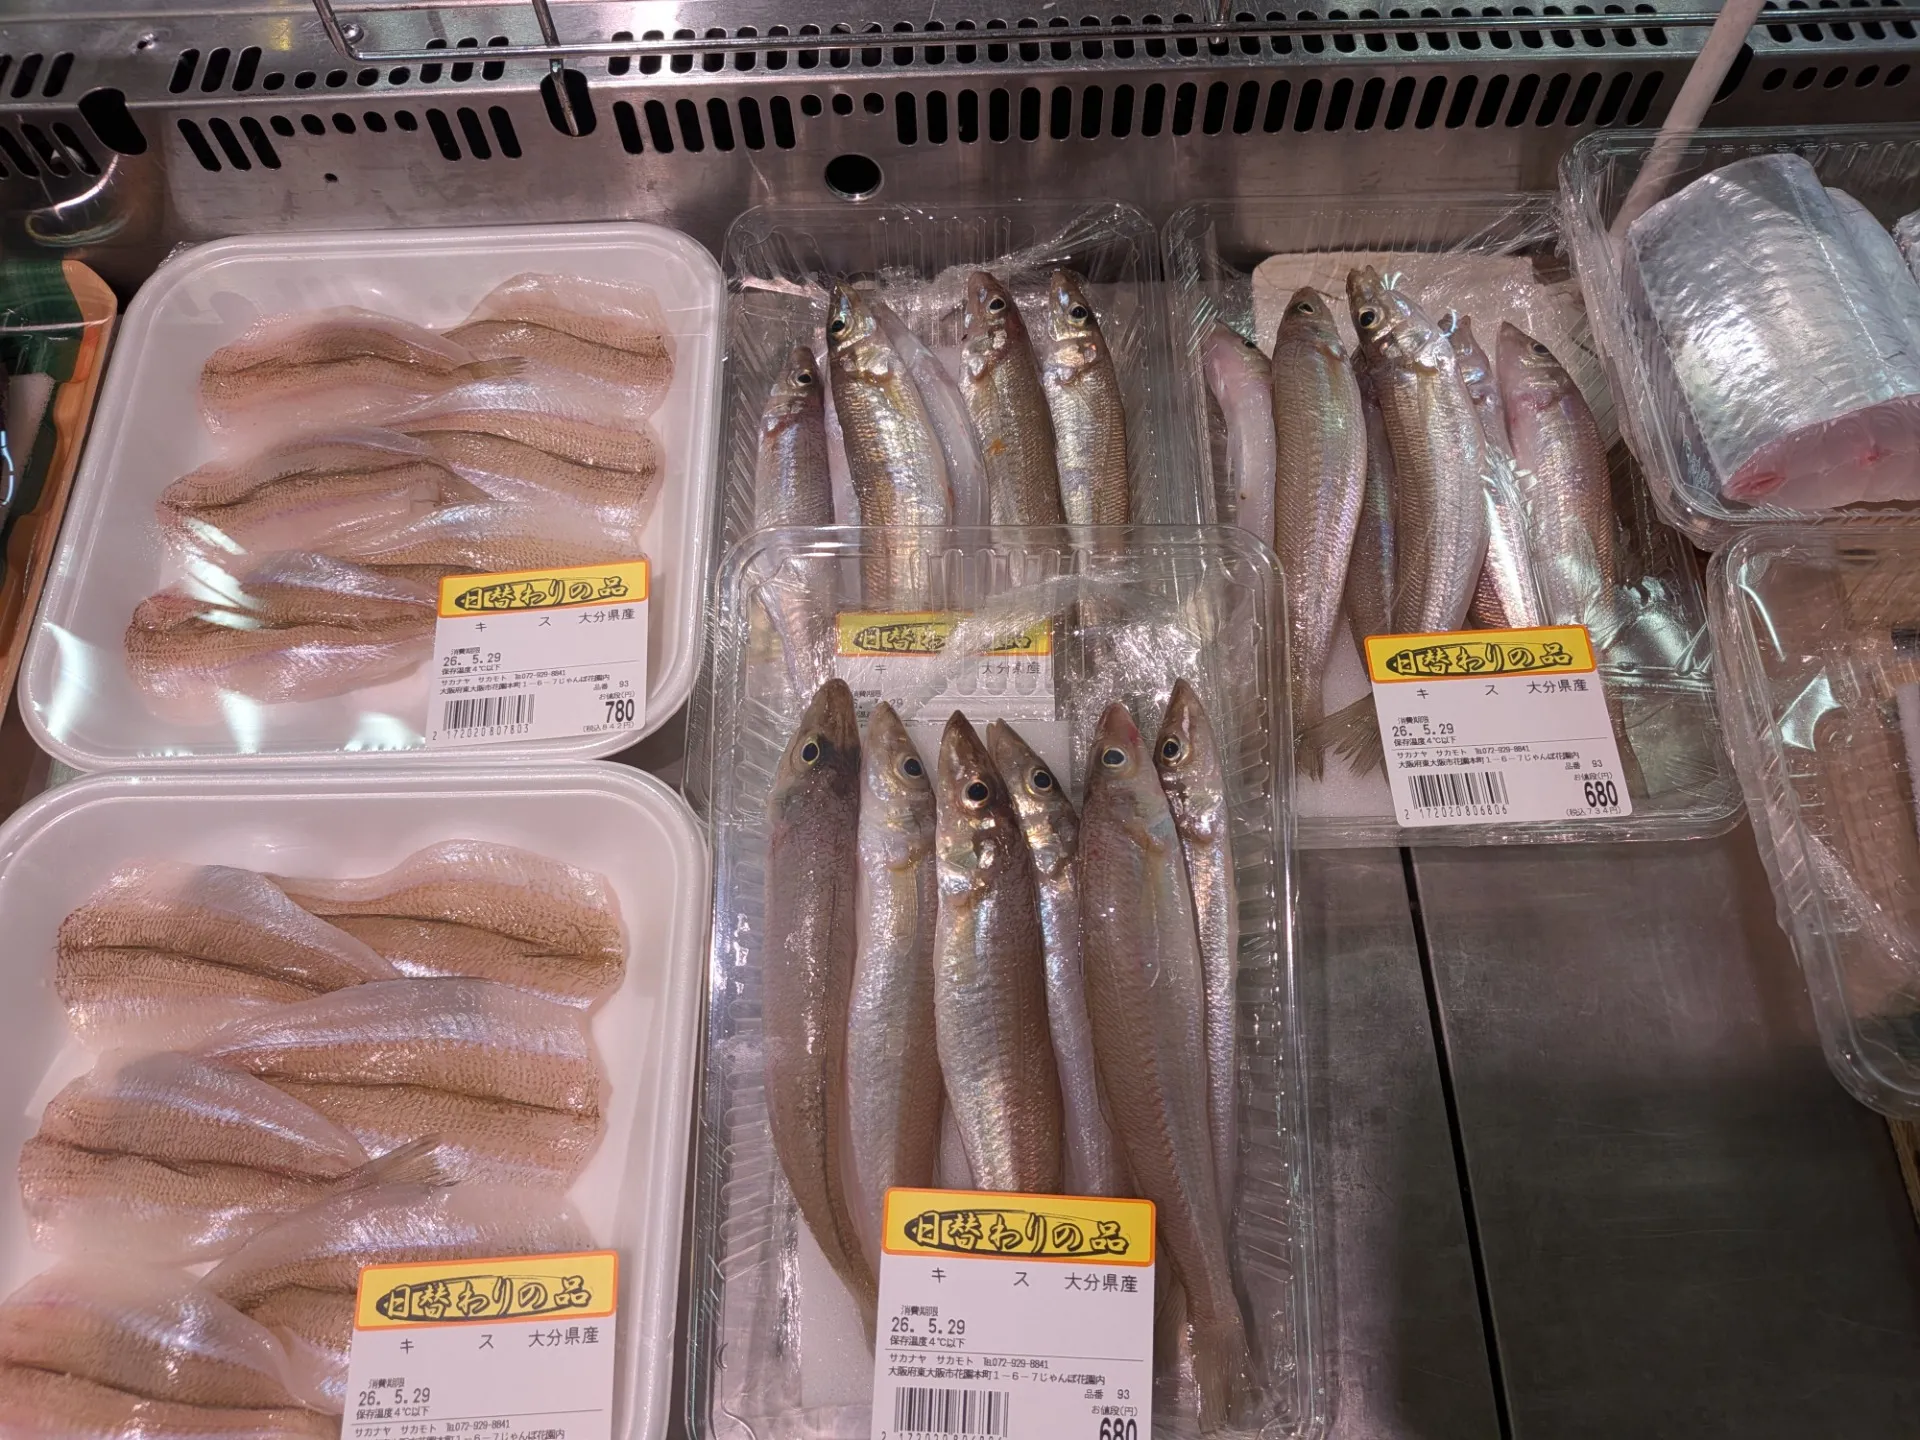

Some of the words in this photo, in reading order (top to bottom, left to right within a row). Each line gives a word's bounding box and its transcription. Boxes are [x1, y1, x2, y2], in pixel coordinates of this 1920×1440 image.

[462, 575, 629, 611] 日替わりの品
[475, 622, 487, 632] キ
[539, 616, 551, 627] ス
[578, 608, 635, 624] 大分県産
[451, 647, 480, 655] 消費期限
[1396, 642, 1573, 675] 日替わりの品
[441, 678, 471, 686] サカナヤ
[478, 675, 506, 683] サカモト
[619, 680, 629, 688] 93
[1416, 688, 1429, 699] キ
[1485, 684, 1499, 696] ス
[1527, 679, 1589, 694] 大分県産
[605, 699, 635, 723] 780
[1398, 716, 1429, 724] 消費期限
[1397, 750, 1427, 758] サカナヤ
[1436, 748, 1466, 756] サカモト
[1591, 759, 1603, 768] 93
[1584, 780, 1618, 808] 680
[912, 1210, 1130, 1255] 日替わりの品
[932, 1267, 946, 1283] キ
[1013, 1271, 1029, 1287] ス
[1064, 1272, 1138, 1293] 大分県産
[386, 1274, 592, 1319] 日替わりの品
[900, 1305, 938, 1317] 消費期限
[400, 1338, 414, 1354] キ
[478, 1334, 494, 1349] ス
[528, 1326, 600, 1347] 大分県産
[890, 1353, 927, 1363] サカナヤ
[936, 1355, 973, 1366] サカモト
[368, 1377, 405, 1389] 消費期限
[1084, 1388, 1104, 1400] 品番
[1117, 1388, 1130, 1400] 93
[1091, 1405, 1138, 1417] お値段(円)
[355, 1426, 391, 1438] サカナヤ
[401, 1424, 436, 1434] サカモト
[1099, 1417, 1137, 1440] 680
